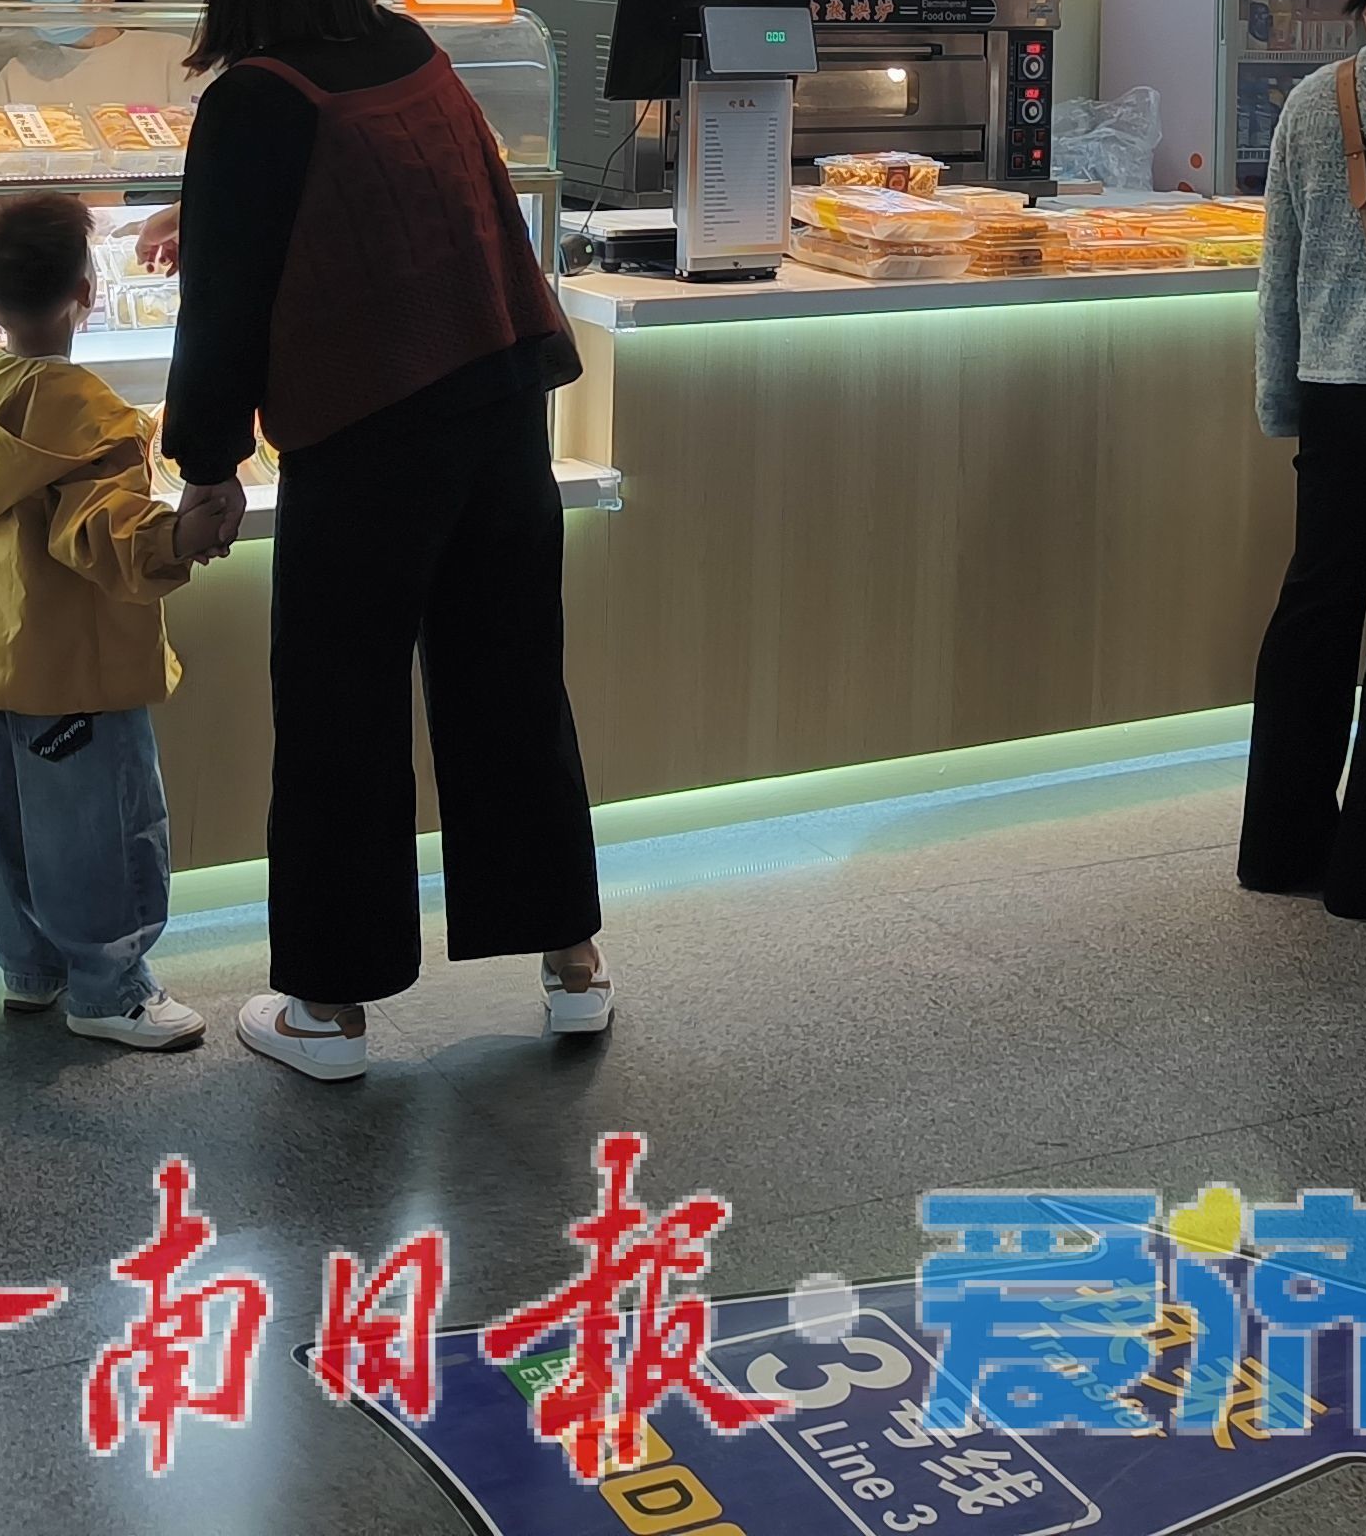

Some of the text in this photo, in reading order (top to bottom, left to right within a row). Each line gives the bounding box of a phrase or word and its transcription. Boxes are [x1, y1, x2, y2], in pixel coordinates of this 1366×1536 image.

[922, 11, 967, 21] Food Oven
[798, 1420, 938, 1533] Line 3
[621, 1478, 693, 1516] D
